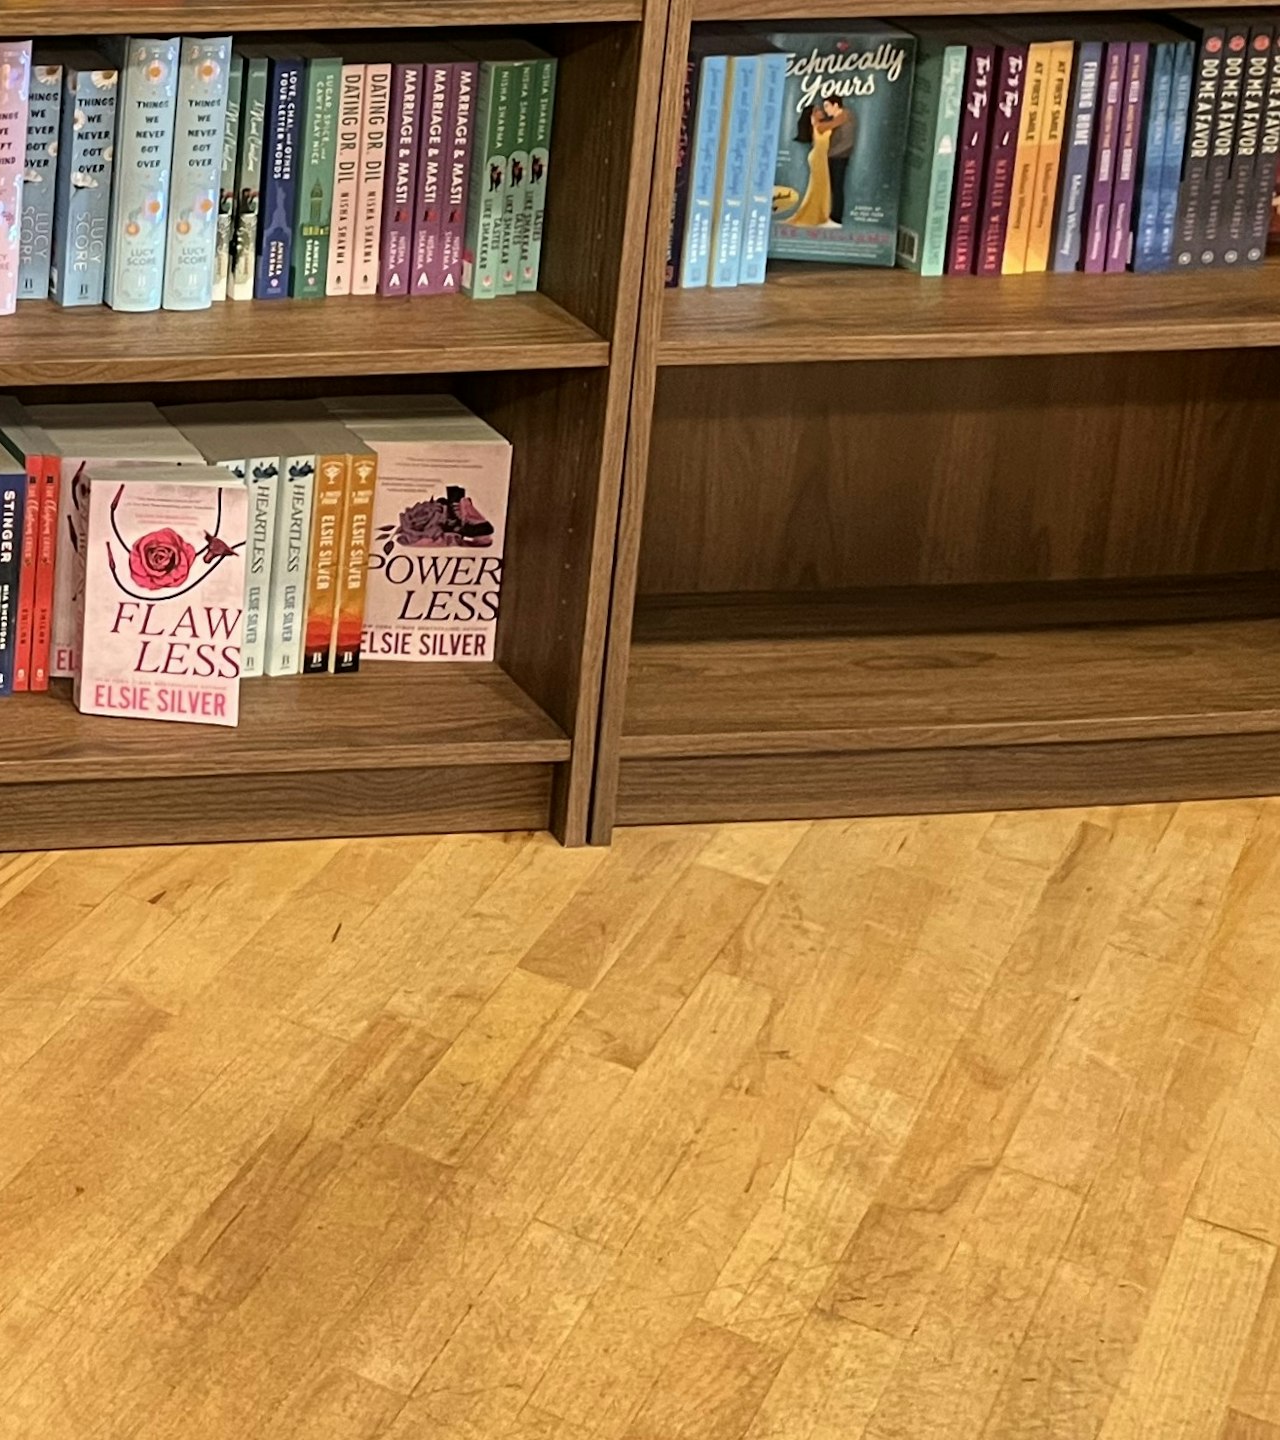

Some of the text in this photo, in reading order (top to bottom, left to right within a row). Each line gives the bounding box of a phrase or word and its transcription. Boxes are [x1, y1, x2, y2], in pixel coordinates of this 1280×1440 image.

[78, 97, 114, 108] THINGS
[796, 73, 876, 111] Yours
[88, 114, 102, 124] WE
[77, 131, 110, 141] NEVER
[450, 69, 473, 205] MARRIAGE & MASTI
[82, 147, 103, 157] GOT
[78, 164, 106, 173] OVER
[0, 490, 16, 563] STINGER
[111, 602, 242, 639] FLAW
[399, 591, 499, 621] LESS
[420, 630, 486, 656] SILVER
[135, 641, 241, 678] LESS
[95, 685, 226, 717] ELSIE SILVER
